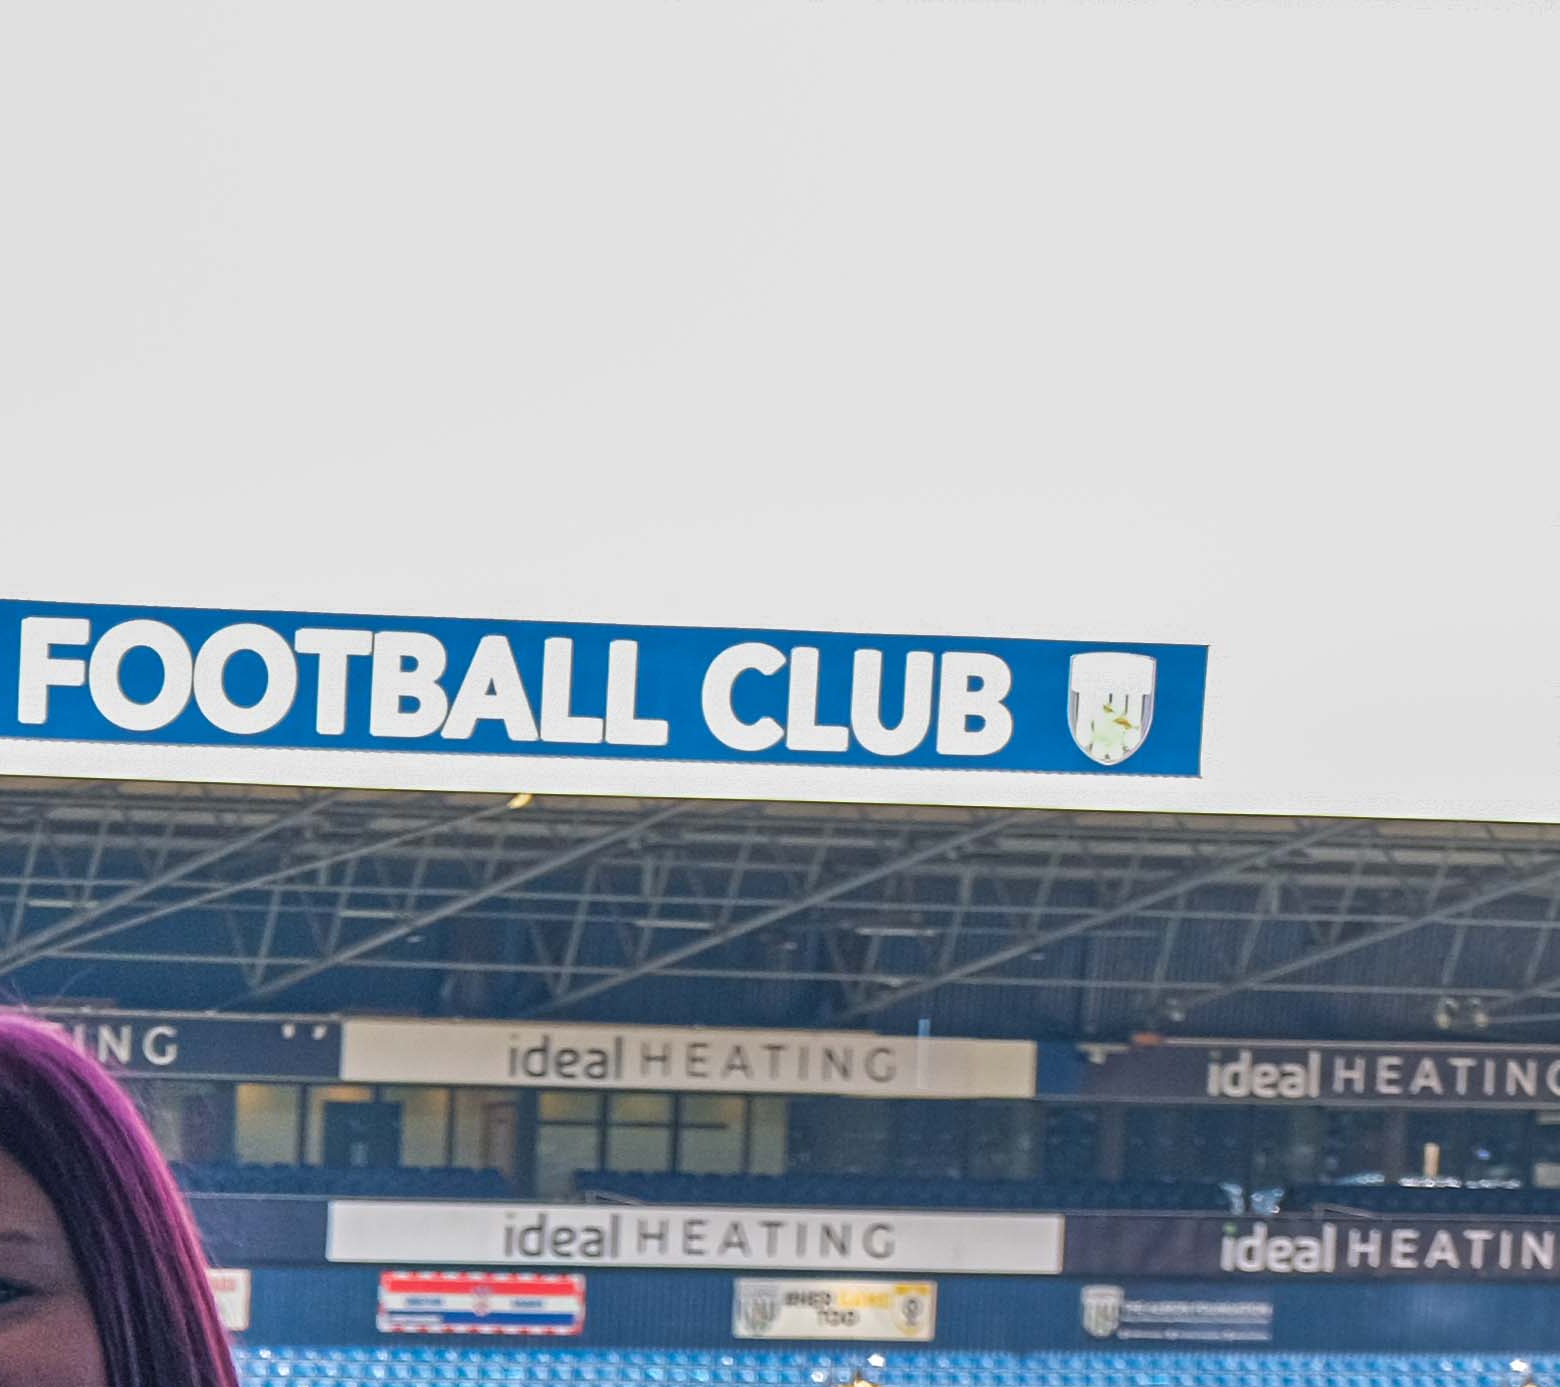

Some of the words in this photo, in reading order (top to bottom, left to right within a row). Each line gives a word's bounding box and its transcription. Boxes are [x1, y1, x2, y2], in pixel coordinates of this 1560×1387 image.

[16, 615, 670, 747] FOOTBALL
[700, 641, 1014, 758] CLUB
[507, 1034, 624, 1081] ideal
[640, 1041, 899, 1084] HEATING
[1206, 1049, 1321, 1099] ideal
[503, 1212, 620, 1260] ideal
[635, 1217, 897, 1260] HEATING
[1220, 1221, 1337, 1274] ideal
[1347, 1228, 1558, 1271] HEATIN
